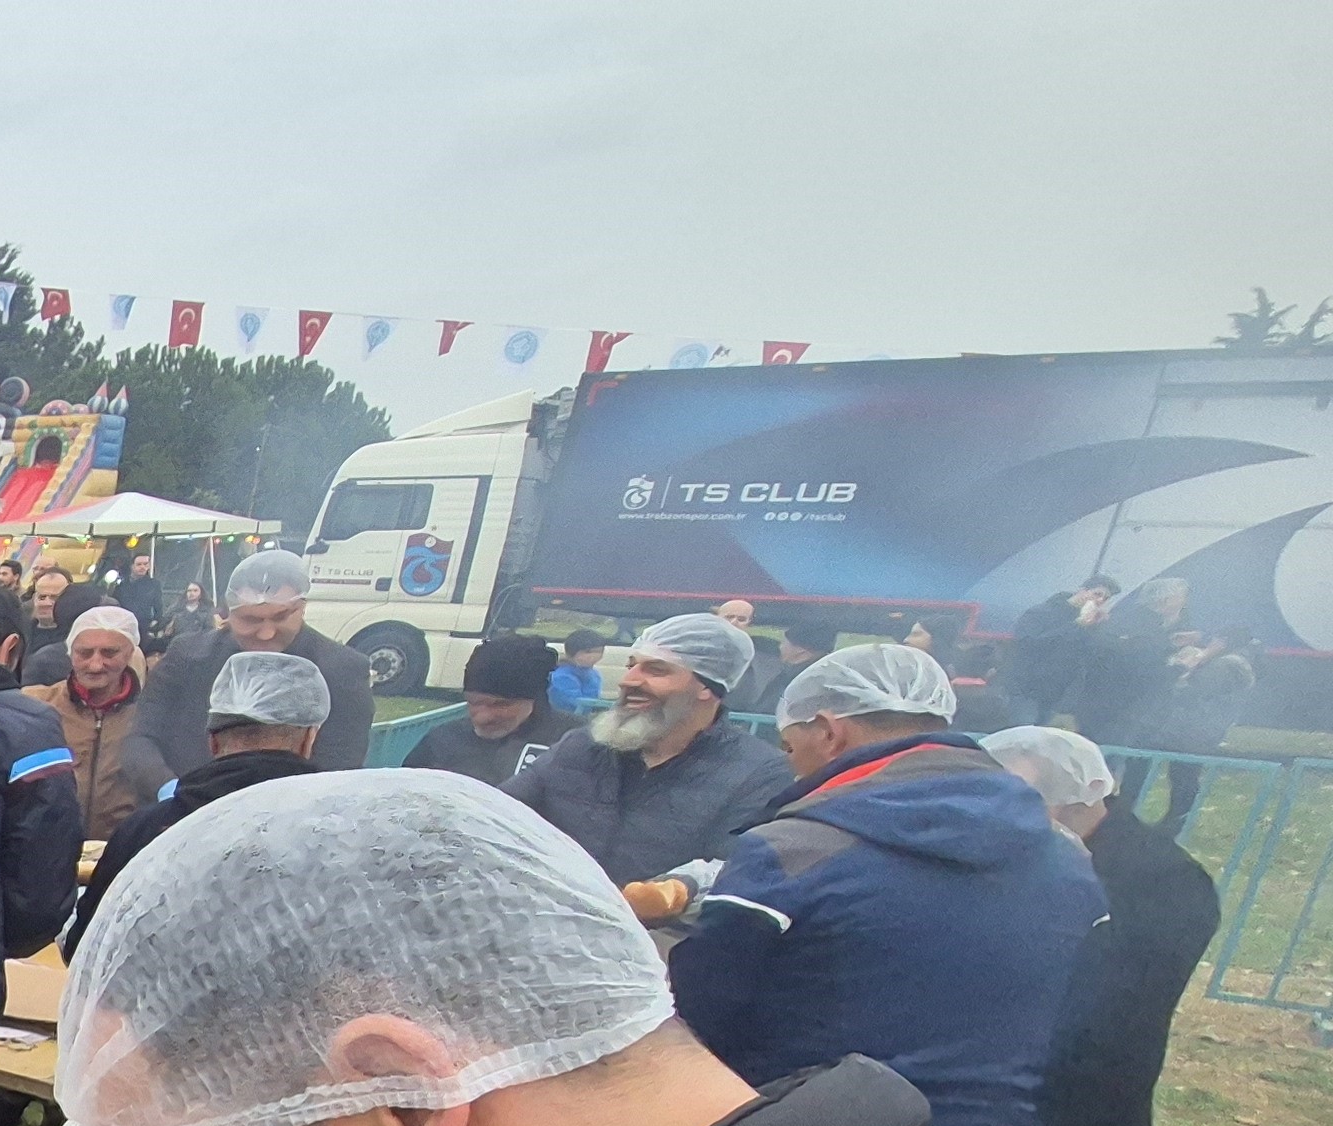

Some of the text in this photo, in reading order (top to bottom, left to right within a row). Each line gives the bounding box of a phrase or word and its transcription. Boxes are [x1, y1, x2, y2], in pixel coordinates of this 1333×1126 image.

[680, 483, 858, 503] TS CLUB
[343, 568, 374, 576] CLUB
